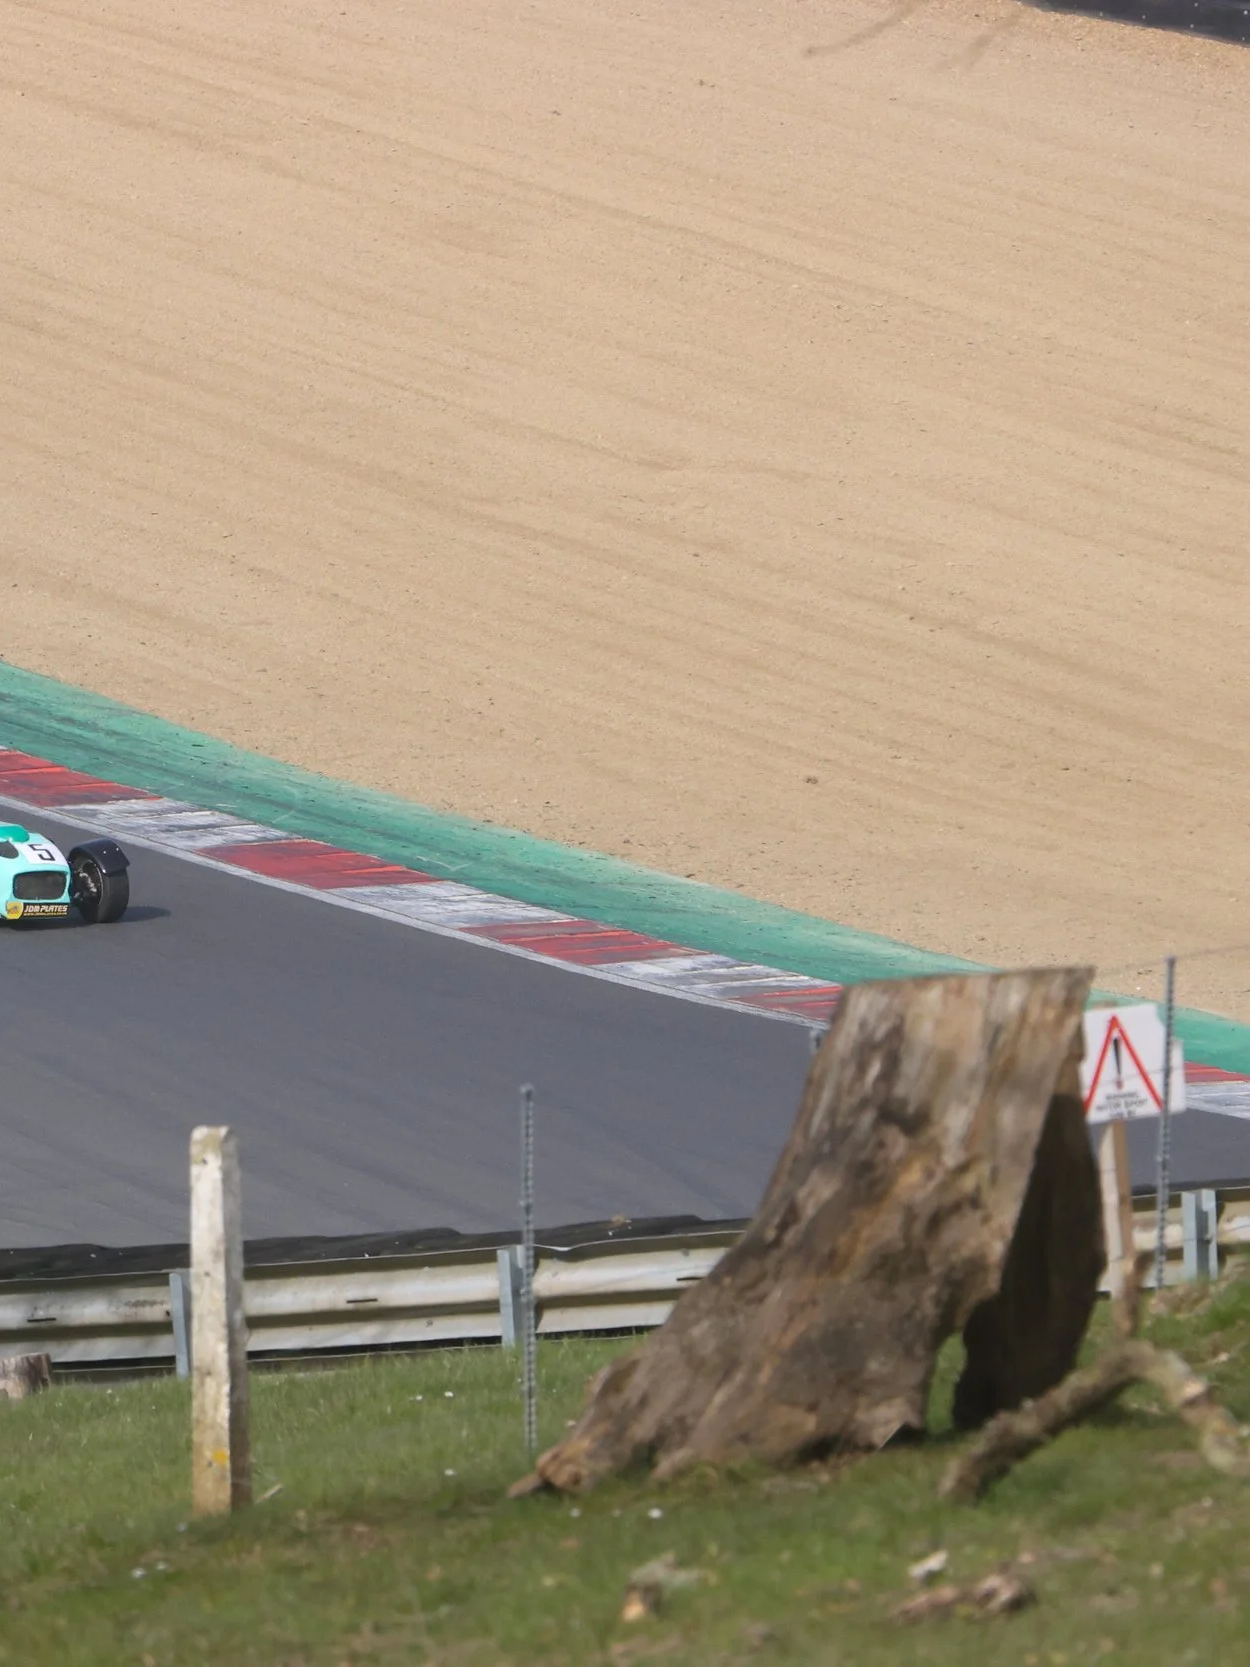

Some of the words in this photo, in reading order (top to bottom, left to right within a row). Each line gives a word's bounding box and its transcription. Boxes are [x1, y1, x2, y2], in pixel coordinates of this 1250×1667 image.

[28, 843, 56, 861] 5
[24, 905, 40, 913] JDM
[40, 905, 68, 913] PLATES
